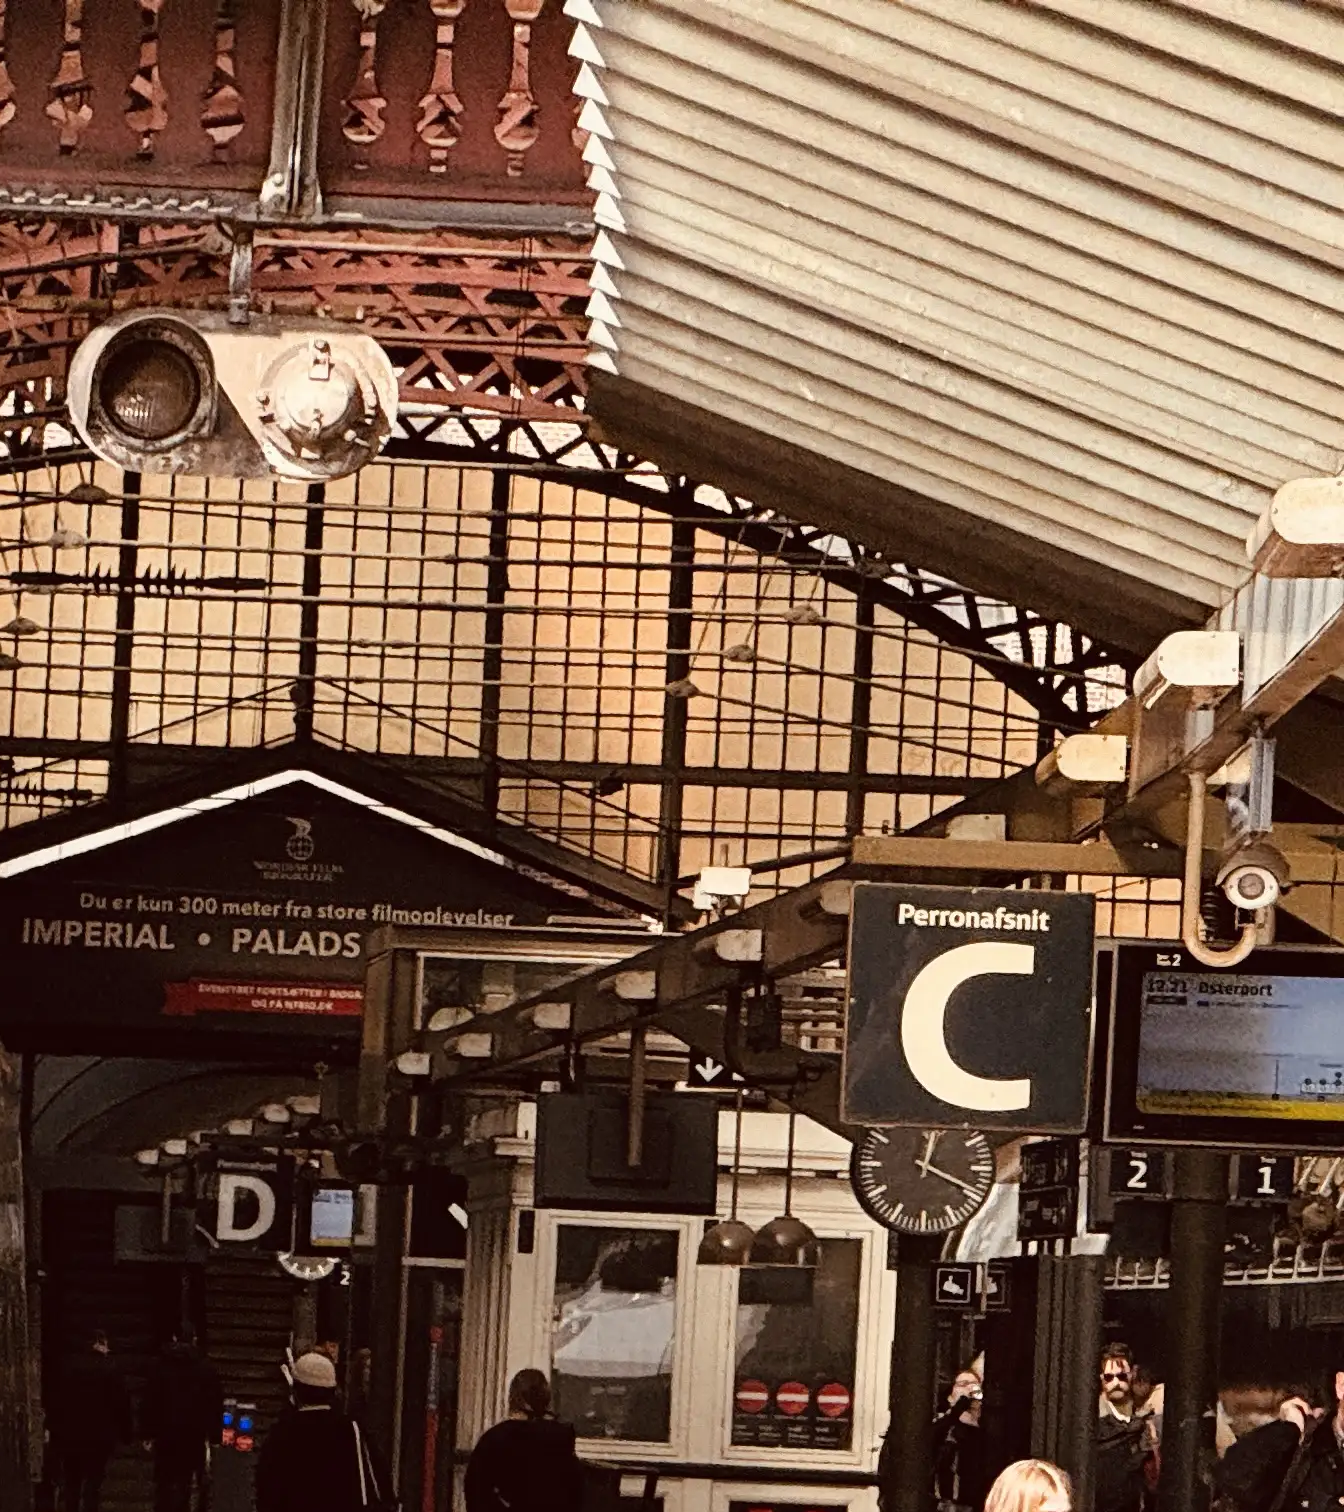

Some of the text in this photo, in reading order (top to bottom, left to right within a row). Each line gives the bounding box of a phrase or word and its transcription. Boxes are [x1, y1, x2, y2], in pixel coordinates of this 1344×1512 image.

[80, 893, 516, 927] Du er kun 300 meter fra store filmoplevelser
[897, 902, 1050, 933] Perronafsnit
[21, 918, 361, 959] IMPERIAL PALADS
[1172, 953, 1182, 967] 2
[900, 941, 1035, 1112] C
[1126, 1160, 1148, 1189] 2
[1256, 1166, 1276, 1195] 1
[215, 1173, 276, 1242] D
[340, 1271, 351, 1287] 2
